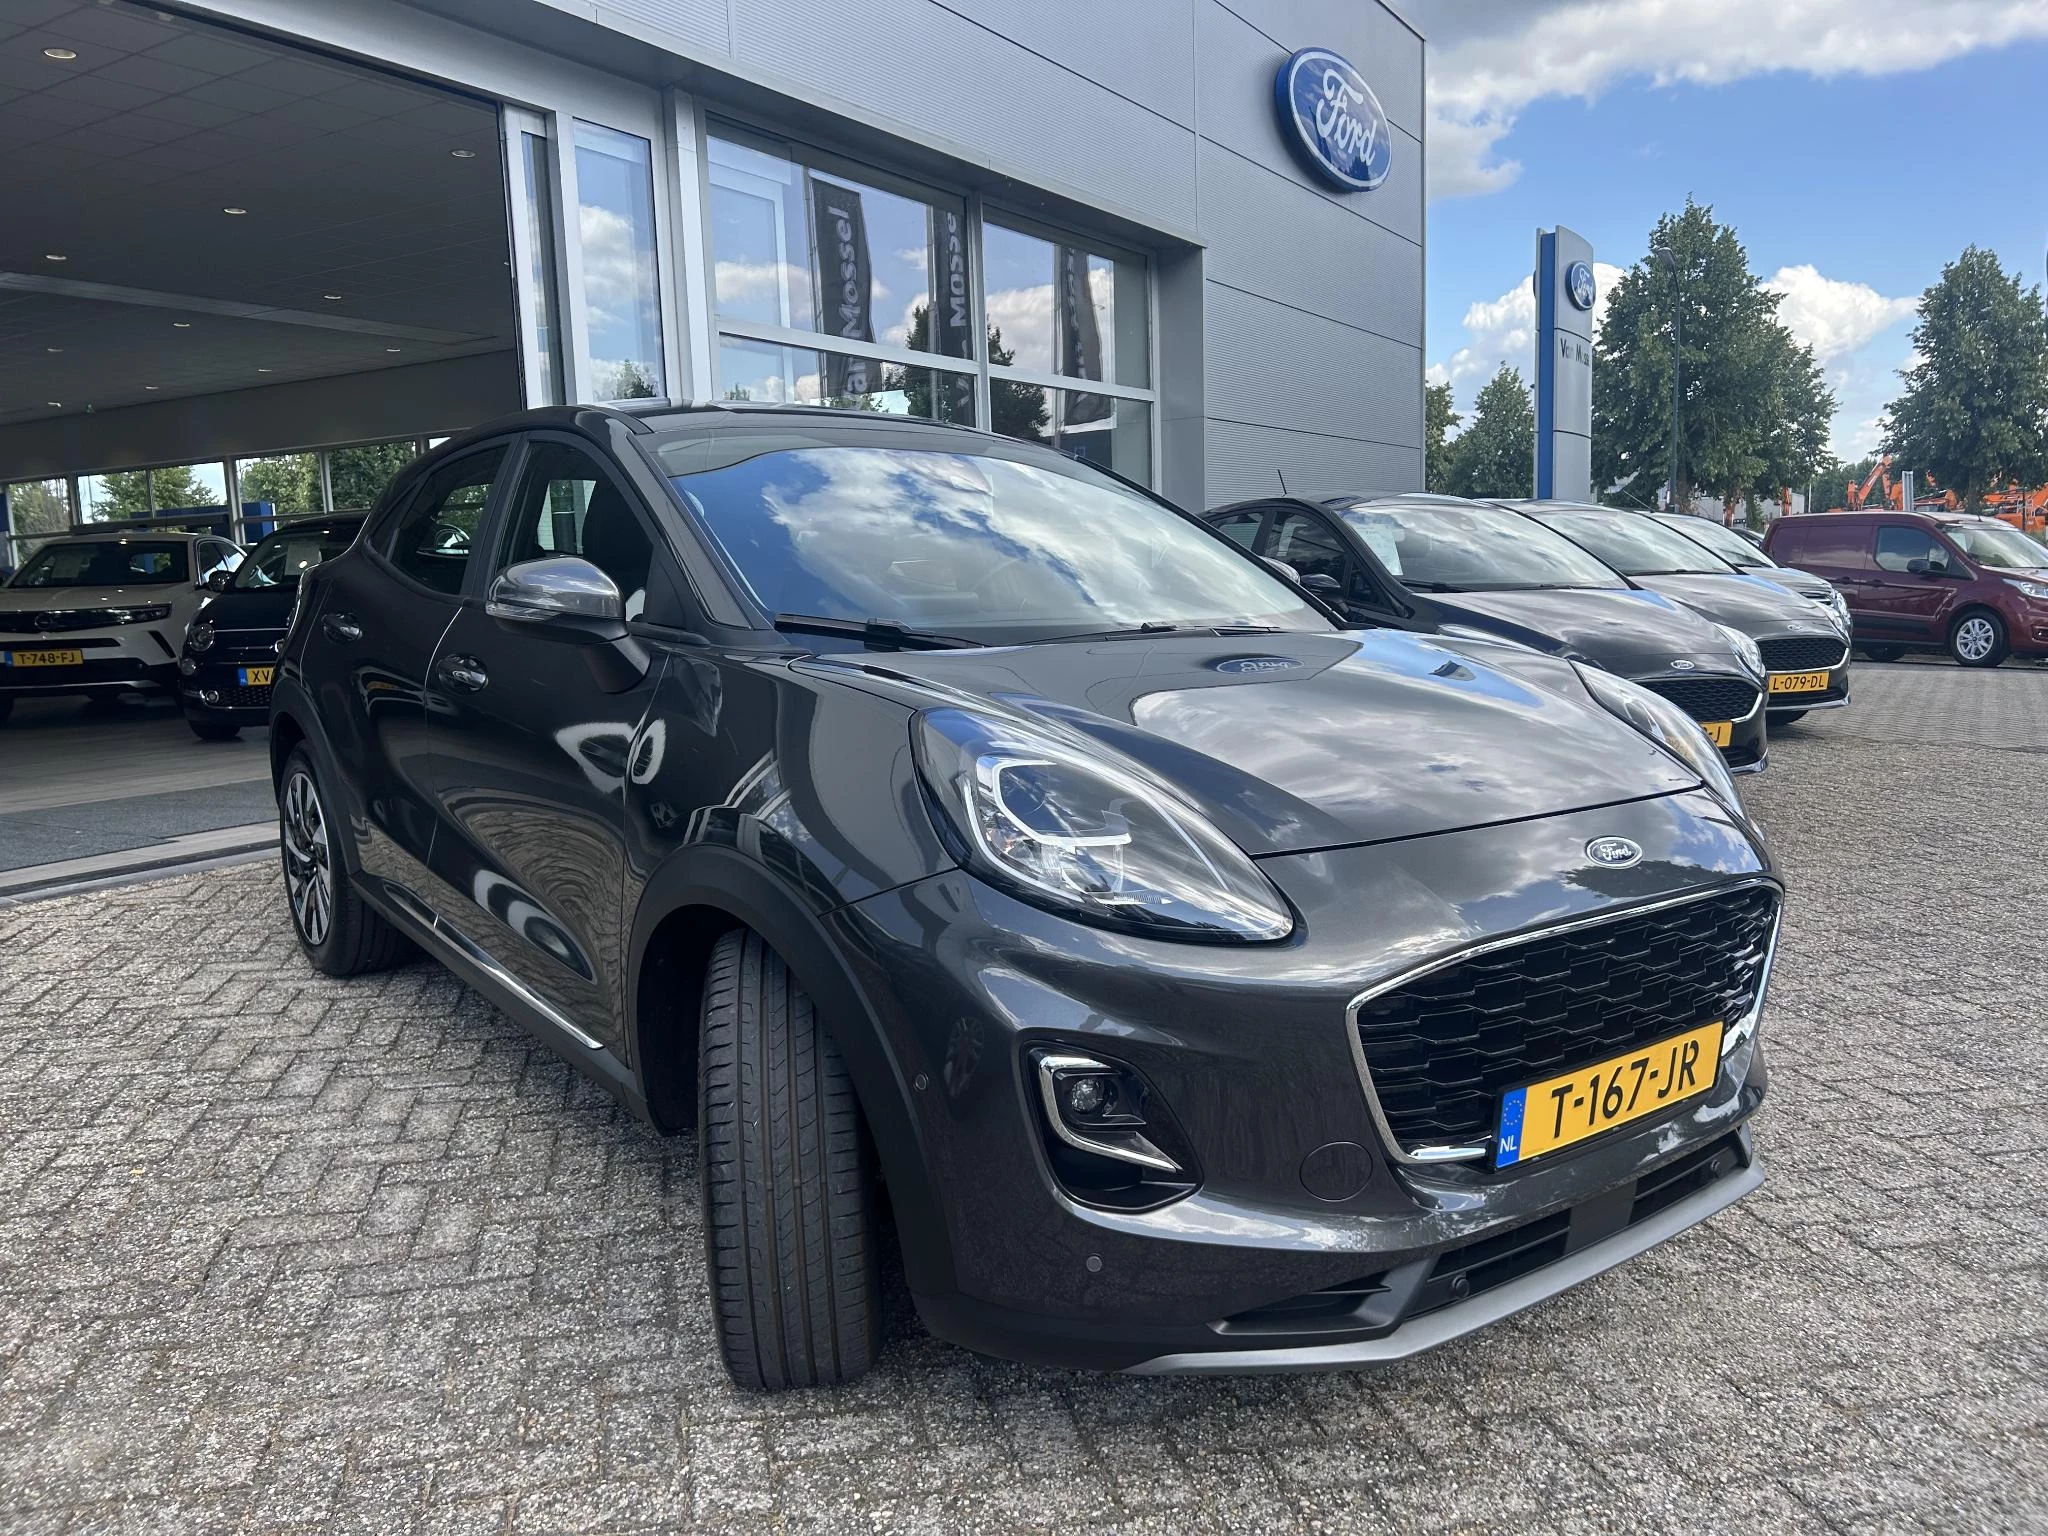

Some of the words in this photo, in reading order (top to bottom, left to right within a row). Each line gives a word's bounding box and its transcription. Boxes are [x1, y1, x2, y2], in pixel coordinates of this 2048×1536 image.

[1315, 67, 1377, 167] Ford
[828, 206, 862, 339] Mossel
[1577, 268, 1594, 298] Ford
[19, 652, 75, 665] T-748-FJ
[252, 670, 270, 683] XV
[1772, 675, 1825, 691] L-079-DL
[1599, 843, 1632, 861] Ford
[1551, 1039, 1700, 1139] T-167-JR
[1499, 1136, 1517, 1155] NL
